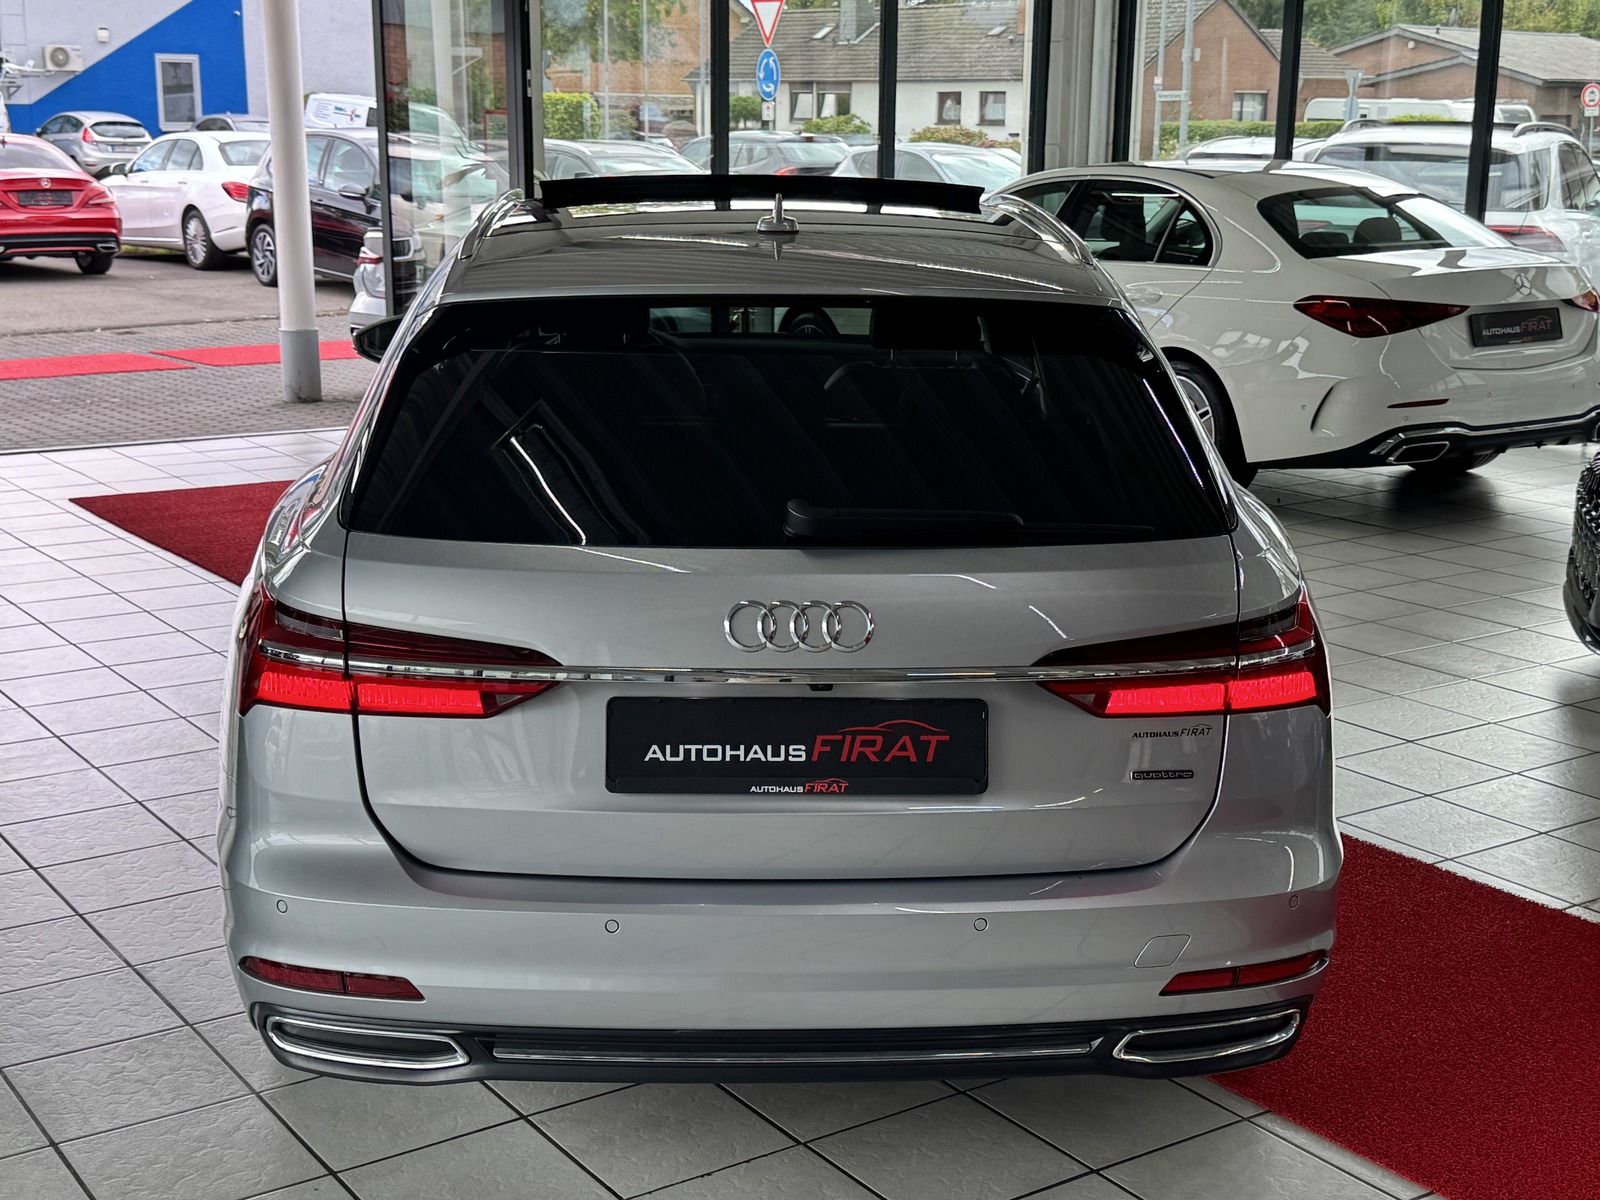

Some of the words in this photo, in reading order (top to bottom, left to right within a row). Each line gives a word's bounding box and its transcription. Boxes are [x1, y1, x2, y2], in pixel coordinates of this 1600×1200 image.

[1481, 326, 1521, 336] AUTOHAUS
[1520, 320, 1553, 332] FIRAT
[1180, 727, 1213, 737] FIRAT
[644, 744, 806, 762] AUTOHAUS
[811, 735, 950, 762] FIRAT
[1134, 772, 1193, 780] quattro
[804, 783, 848, 793] FIRAT
